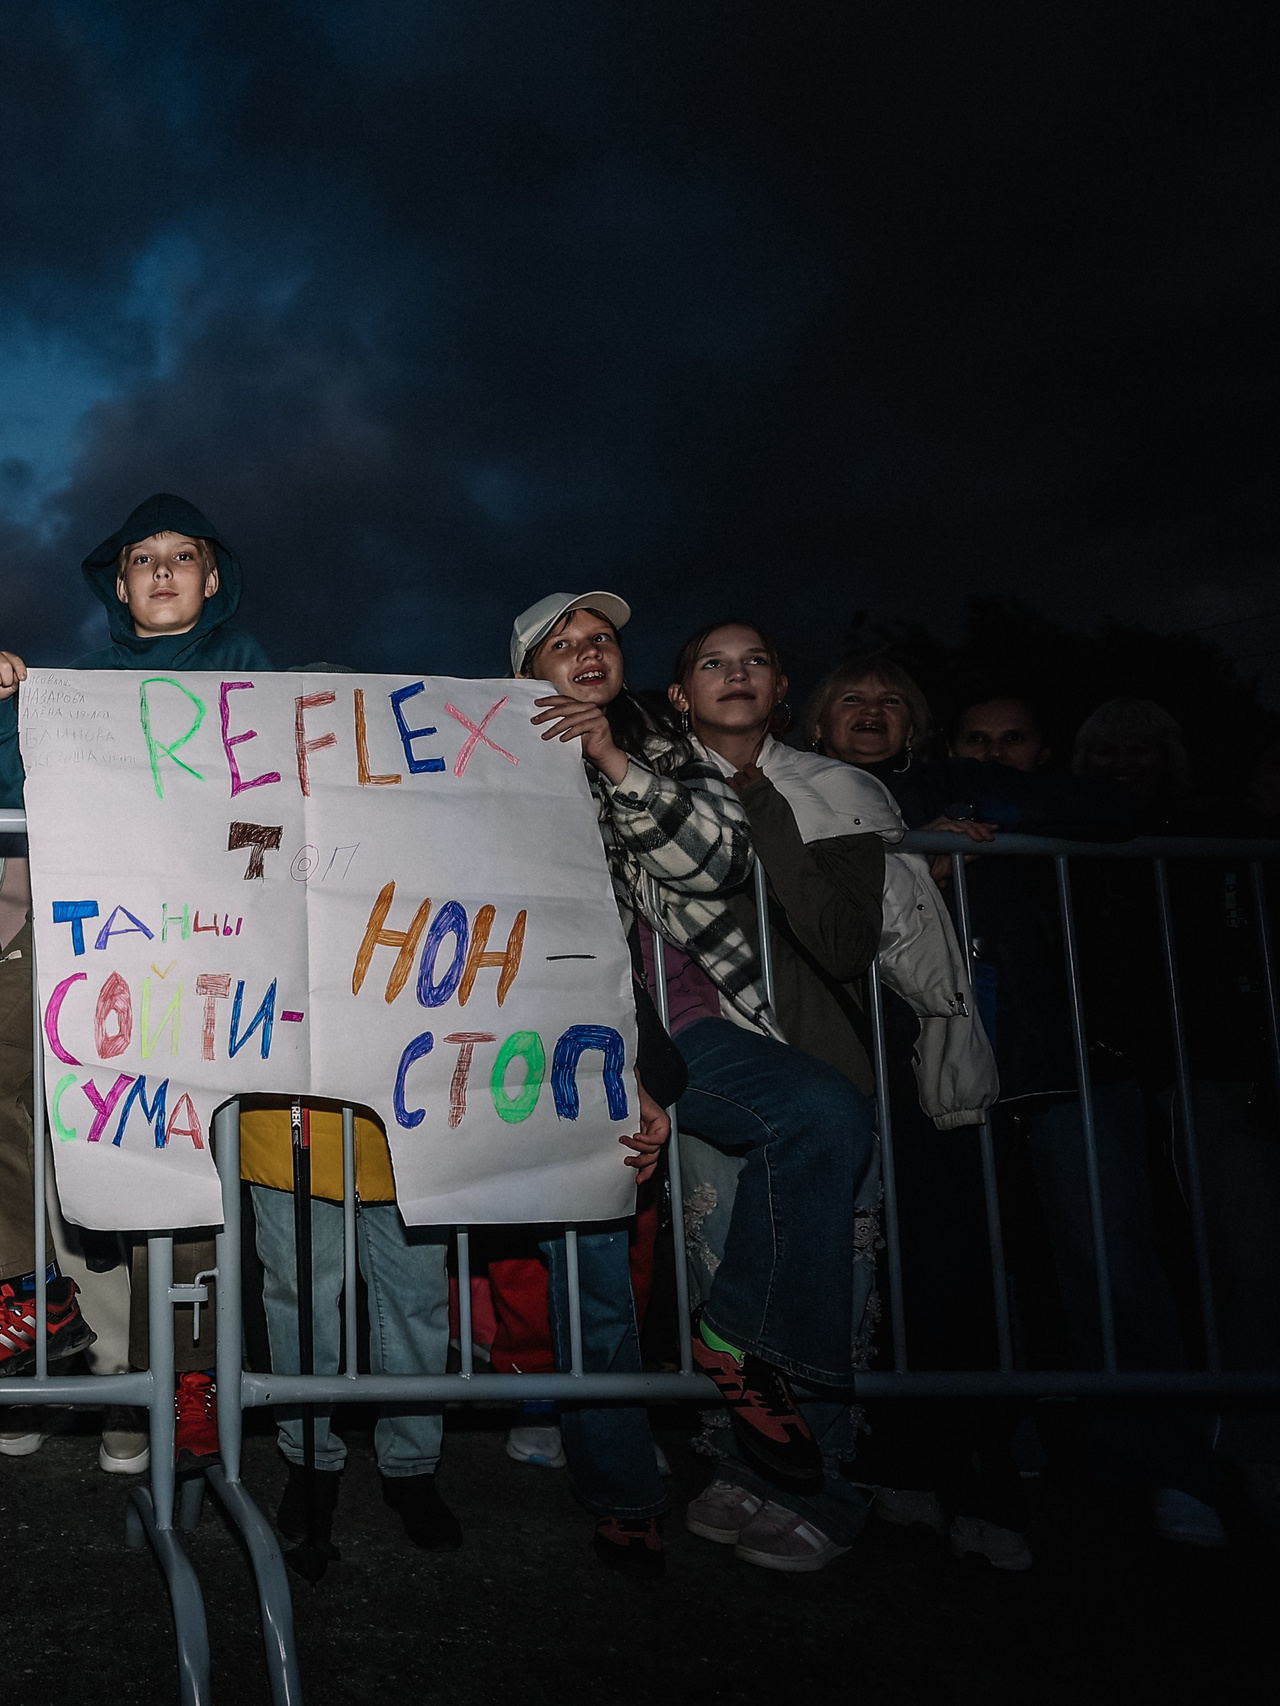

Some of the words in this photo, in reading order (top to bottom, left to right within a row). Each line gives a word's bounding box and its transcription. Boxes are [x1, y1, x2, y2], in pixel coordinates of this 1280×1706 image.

[28, 673, 72, 687] исовали:
[139, 677, 520, 799] REFLEX
[43, 960, 305, 1067] СОЙТИ-
[53, 1072, 205, 1150] СУМА
[394, 1023, 629, 1130] СТОП
